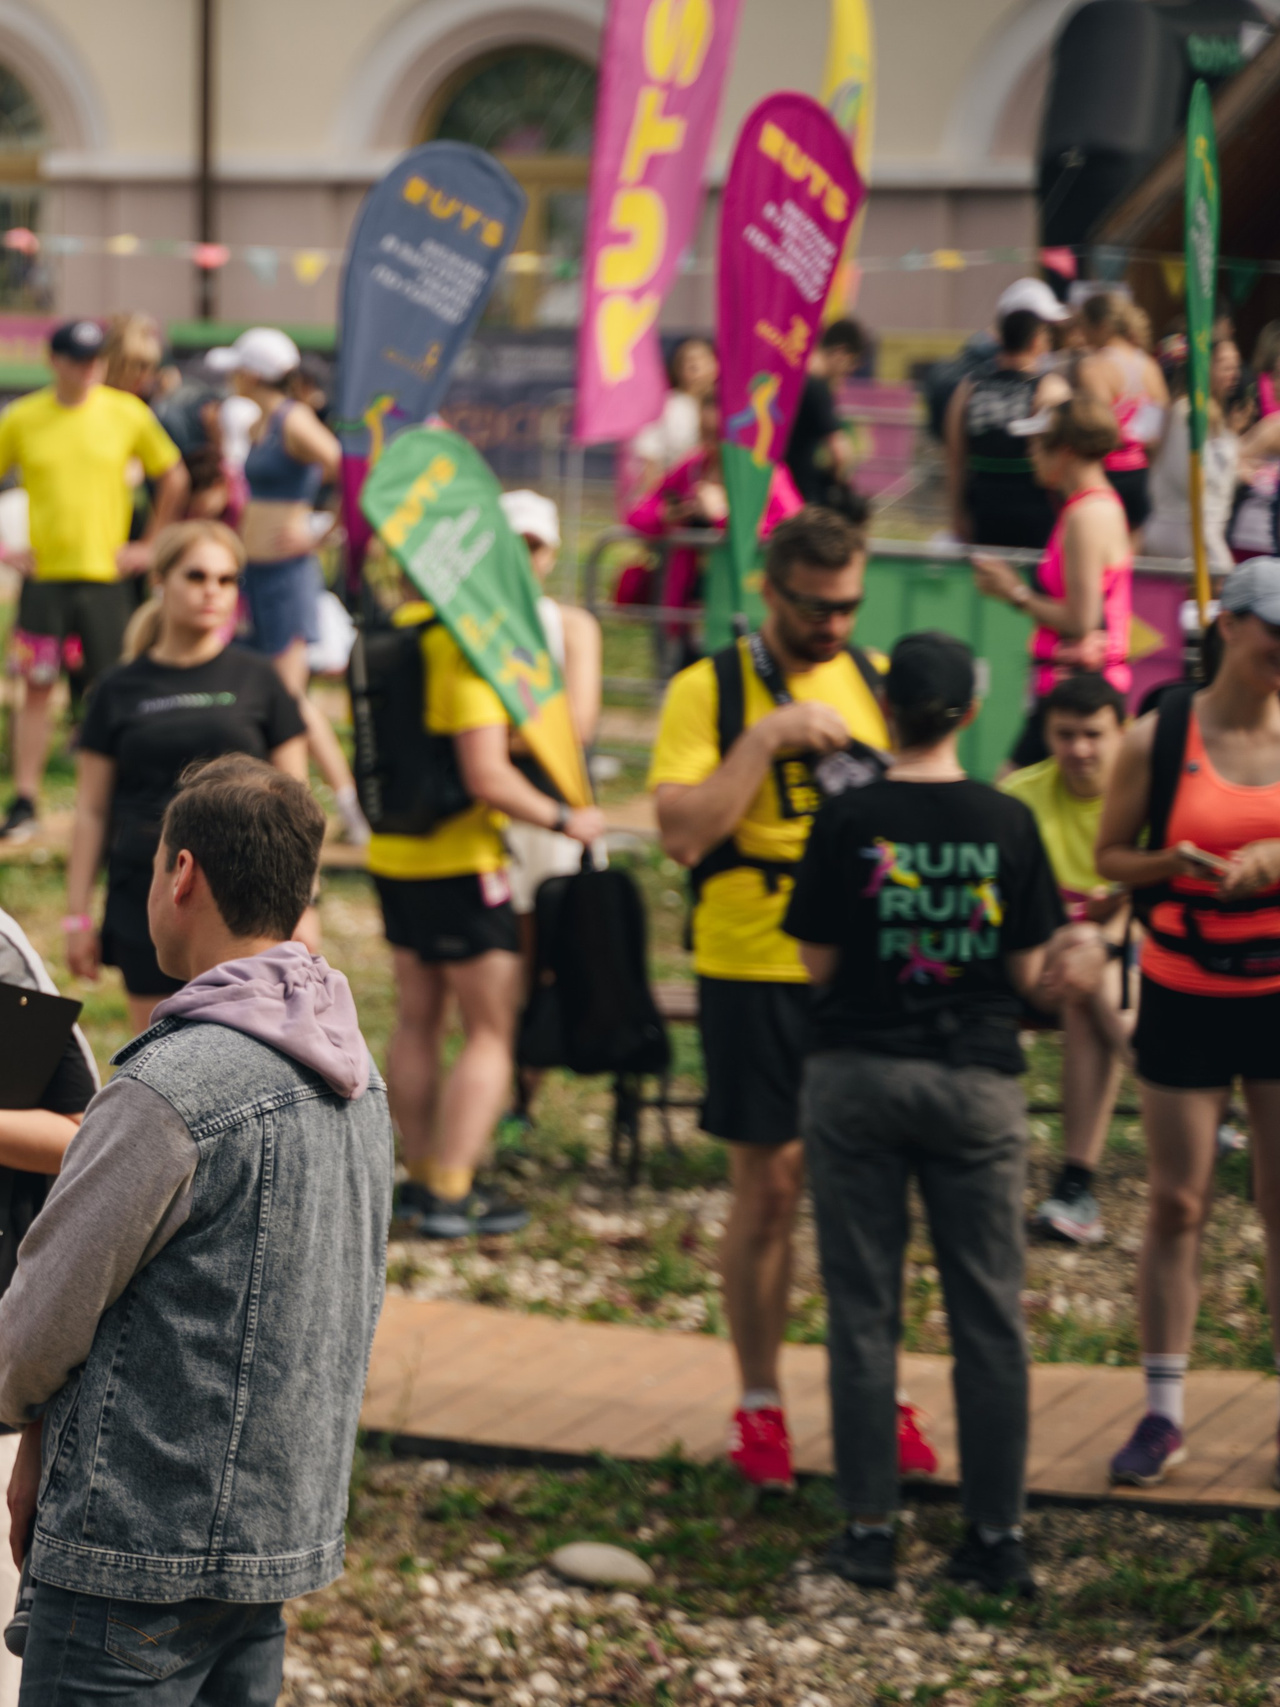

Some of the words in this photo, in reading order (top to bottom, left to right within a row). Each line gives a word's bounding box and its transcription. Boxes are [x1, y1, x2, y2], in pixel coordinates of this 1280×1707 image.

[880, 841, 999, 879] RUN
[879, 886, 999, 922] RUN
[879, 927, 999, 962] RUN
